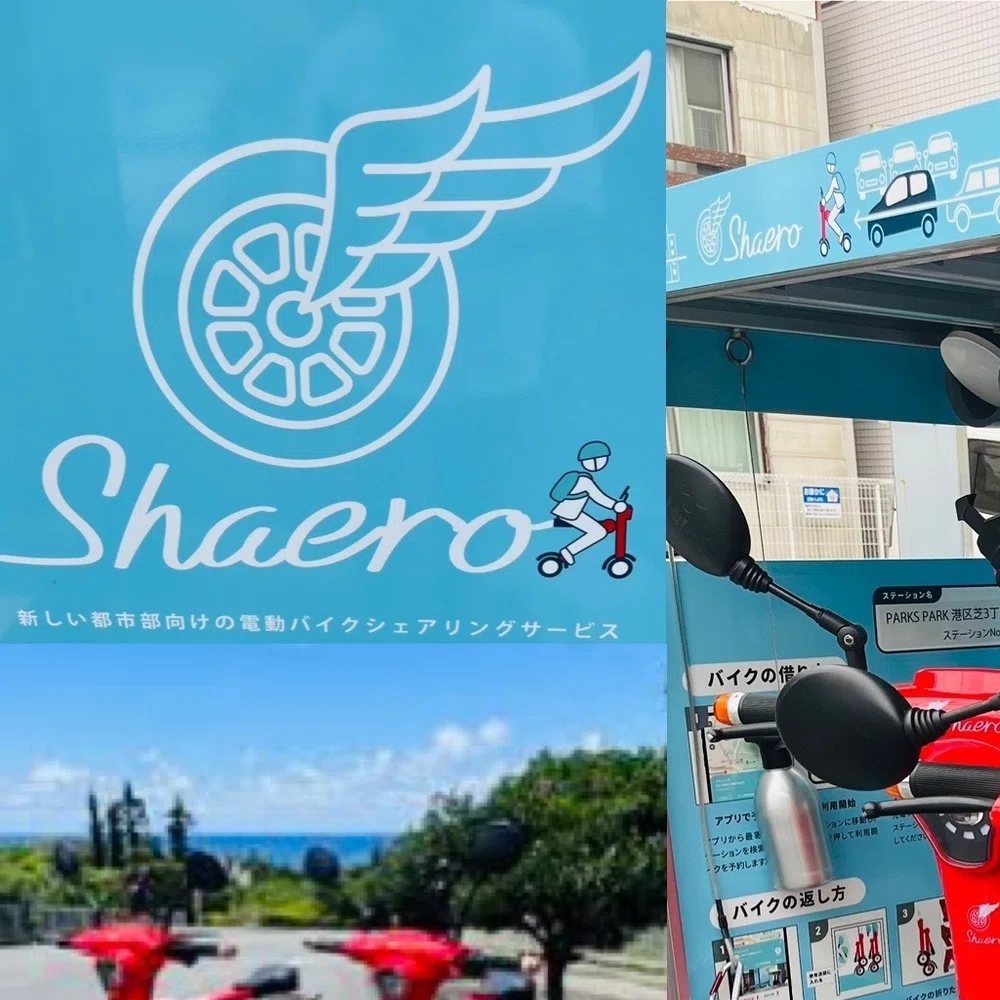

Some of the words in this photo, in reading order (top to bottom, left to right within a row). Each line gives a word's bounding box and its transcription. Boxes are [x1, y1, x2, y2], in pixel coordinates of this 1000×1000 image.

[722, 214, 803, 258] Shaero
[0, 434, 545, 573] Shaero
[882, 590, 933, 600] ステーション名
[16, 607, 621, 641] 新しい都市部向けの電動バイクシェアリングサービス
[885, 610, 920, 625] PARKS
[922, 609, 950, 622] PARK
[708, 662, 815, 687] バイクの借
[733, 885, 846, 920] バイクの返し方
[815, 925, 822, 936] 2
